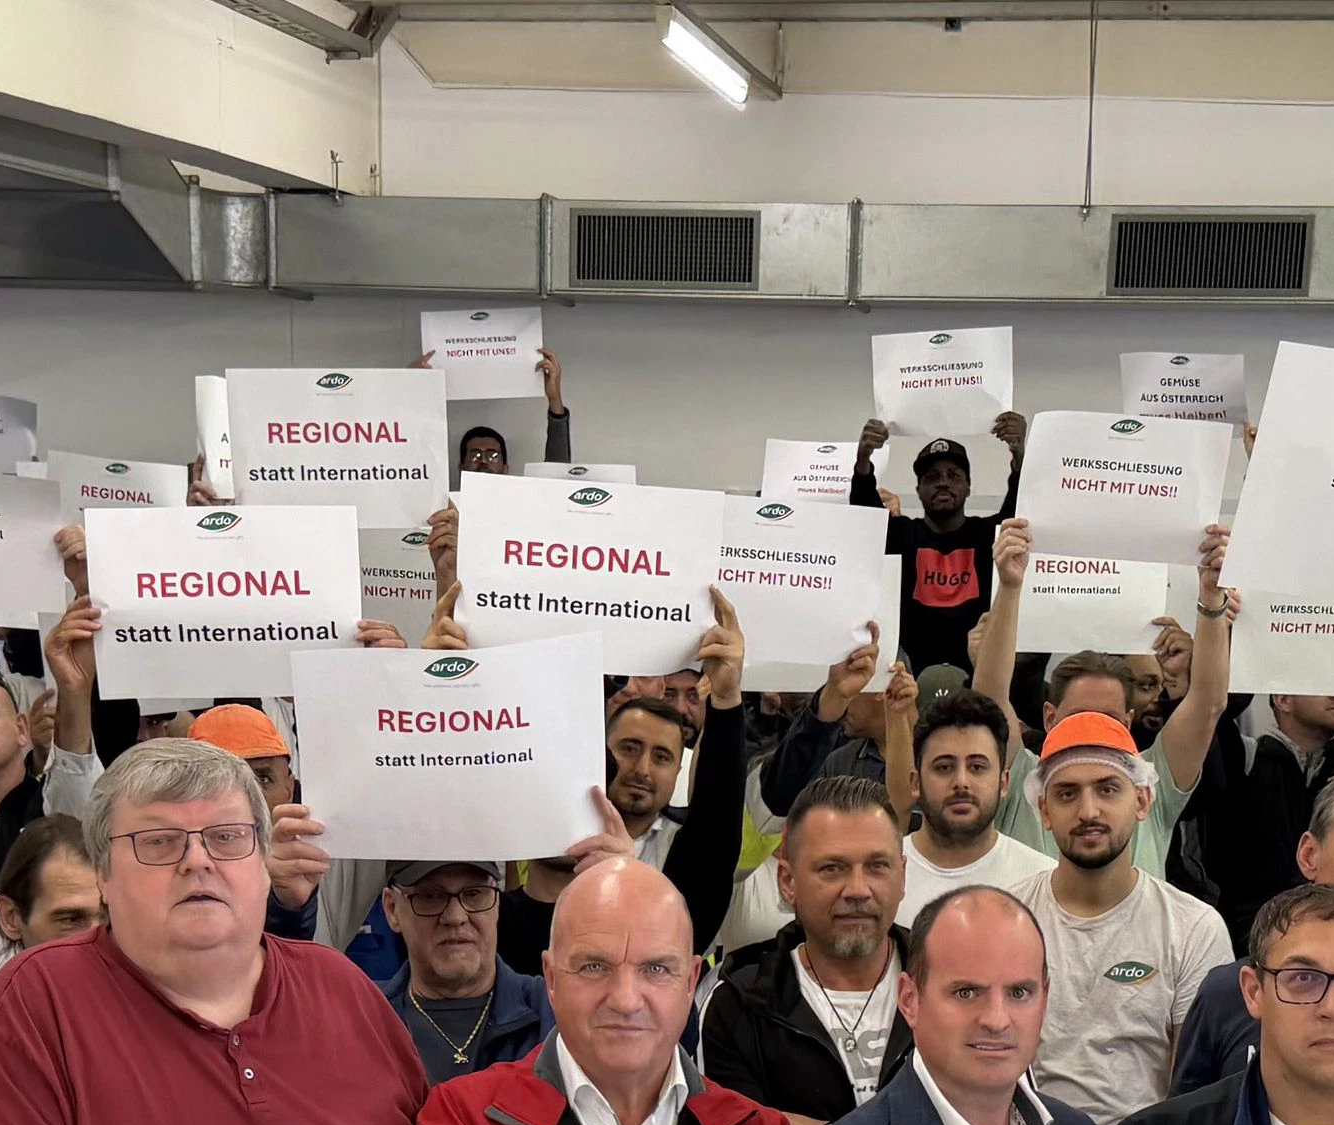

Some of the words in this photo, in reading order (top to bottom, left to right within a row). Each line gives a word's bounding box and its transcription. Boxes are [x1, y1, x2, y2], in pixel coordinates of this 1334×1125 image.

[320, 375, 345, 386] ardo
[902, 379, 932, 389] NICHT
[935, 378, 951, 386] MIT
[955, 376, 982, 386] UNS!!
[1160, 377, 1200, 387] GEMÜSE
[1140, 393, 1158, 402] AUS
[1161, 394, 1223, 403] ÖSTERREICH
[268, 422, 407, 443] REGIONAL
[249, 467, 295, 481] statt
[301, 464, 429, 480] International
[1062, 457, 1182, 475] WERKSSCHLIESSUNG
[81, 485, 153, 504] REGIONAL
[573, 489, 604, 503] ardo
[1062, 478, 1107, 492] NICHT
[1110, 482, 1135, 494] MIT
[1139, 484, 1177, 497] UNS!!
[201, 514, 233, 528] ardo
[504, 540, 670, 576] REGIONAL
[721, 546, 836, 565] RKSSCHLIESSUNG
[1036, 560, 1120, 574] REGIONAL
[137, 570, 310, 598] REGIONAL
[719, 569, 755, 583] ICHT
[759, 572, 786, 585] MIT
[790, 574, 831, 589] UNS!!
[365, 586, 405, 598] NICHT
[410, 589, 432, 600] MIT
[1058, 586, 1120, 594] International
[477, 591, 531, 610] statt
[539, 593, 691, 622] International
[115, 626, 172, 642] statt
[179, 621, 338, 642] International
[1271, 623, 1312, 633] NICHT
[430, 659, 467, 675] ardo
[378, 706, 530, 733] REGIONAL
[376, 755, 415, 766] statt
[421, 748, 533, 766] International
[1110, 965, 1147, 979] ardo
